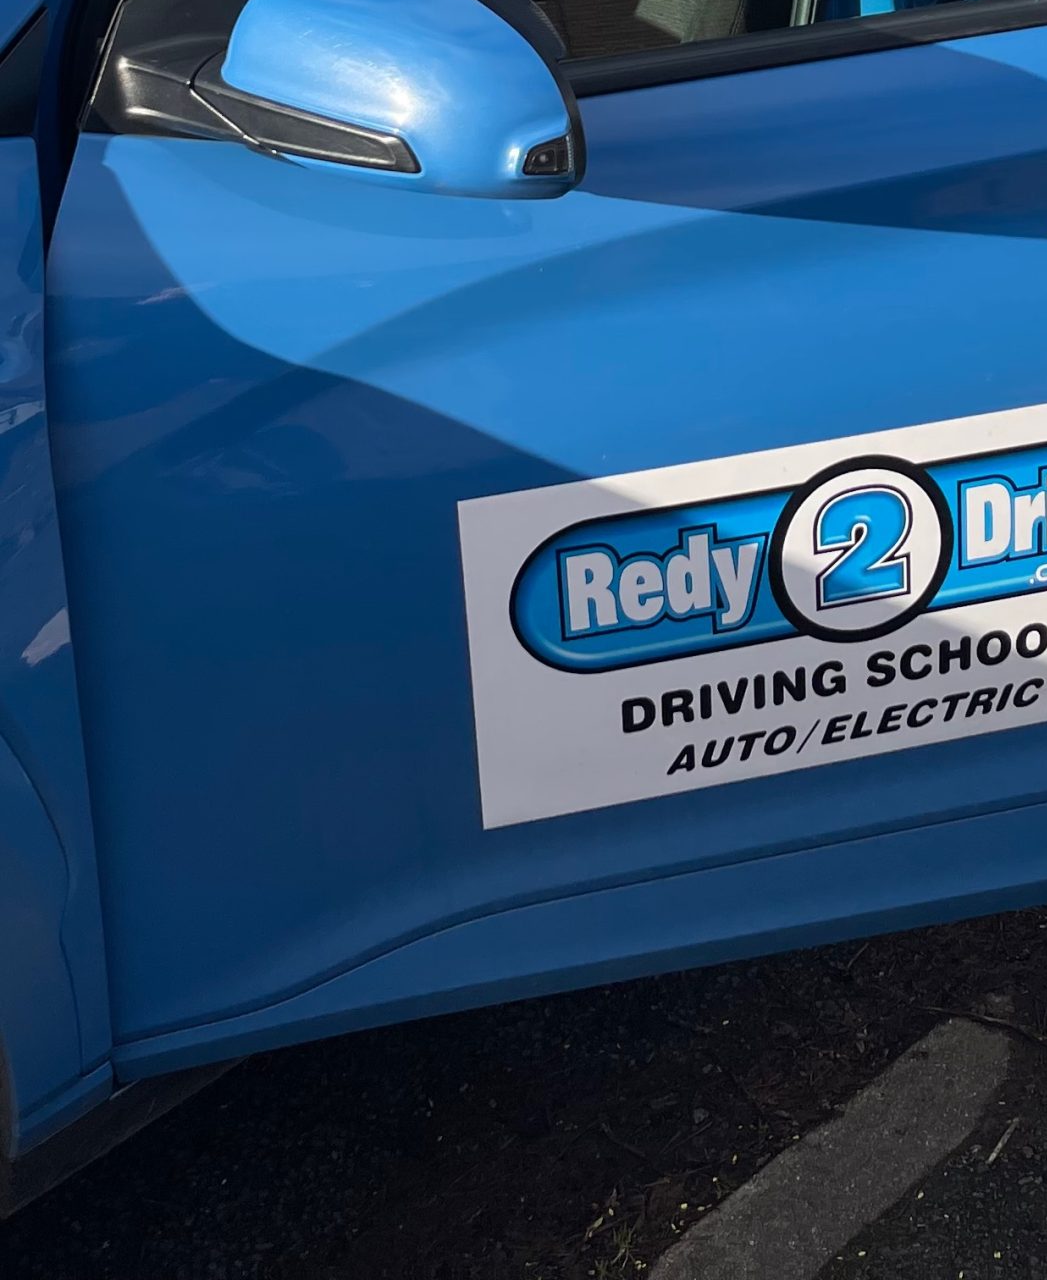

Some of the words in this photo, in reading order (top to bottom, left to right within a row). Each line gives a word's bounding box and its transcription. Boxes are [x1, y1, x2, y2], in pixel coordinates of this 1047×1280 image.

[564, 534, 761, 629] Redy
[813, 484, 912, 610] 2
[621, 660, 848, 734] DRIVING
[666, 677, 1045, 776] AUTO/ELECTRIC
